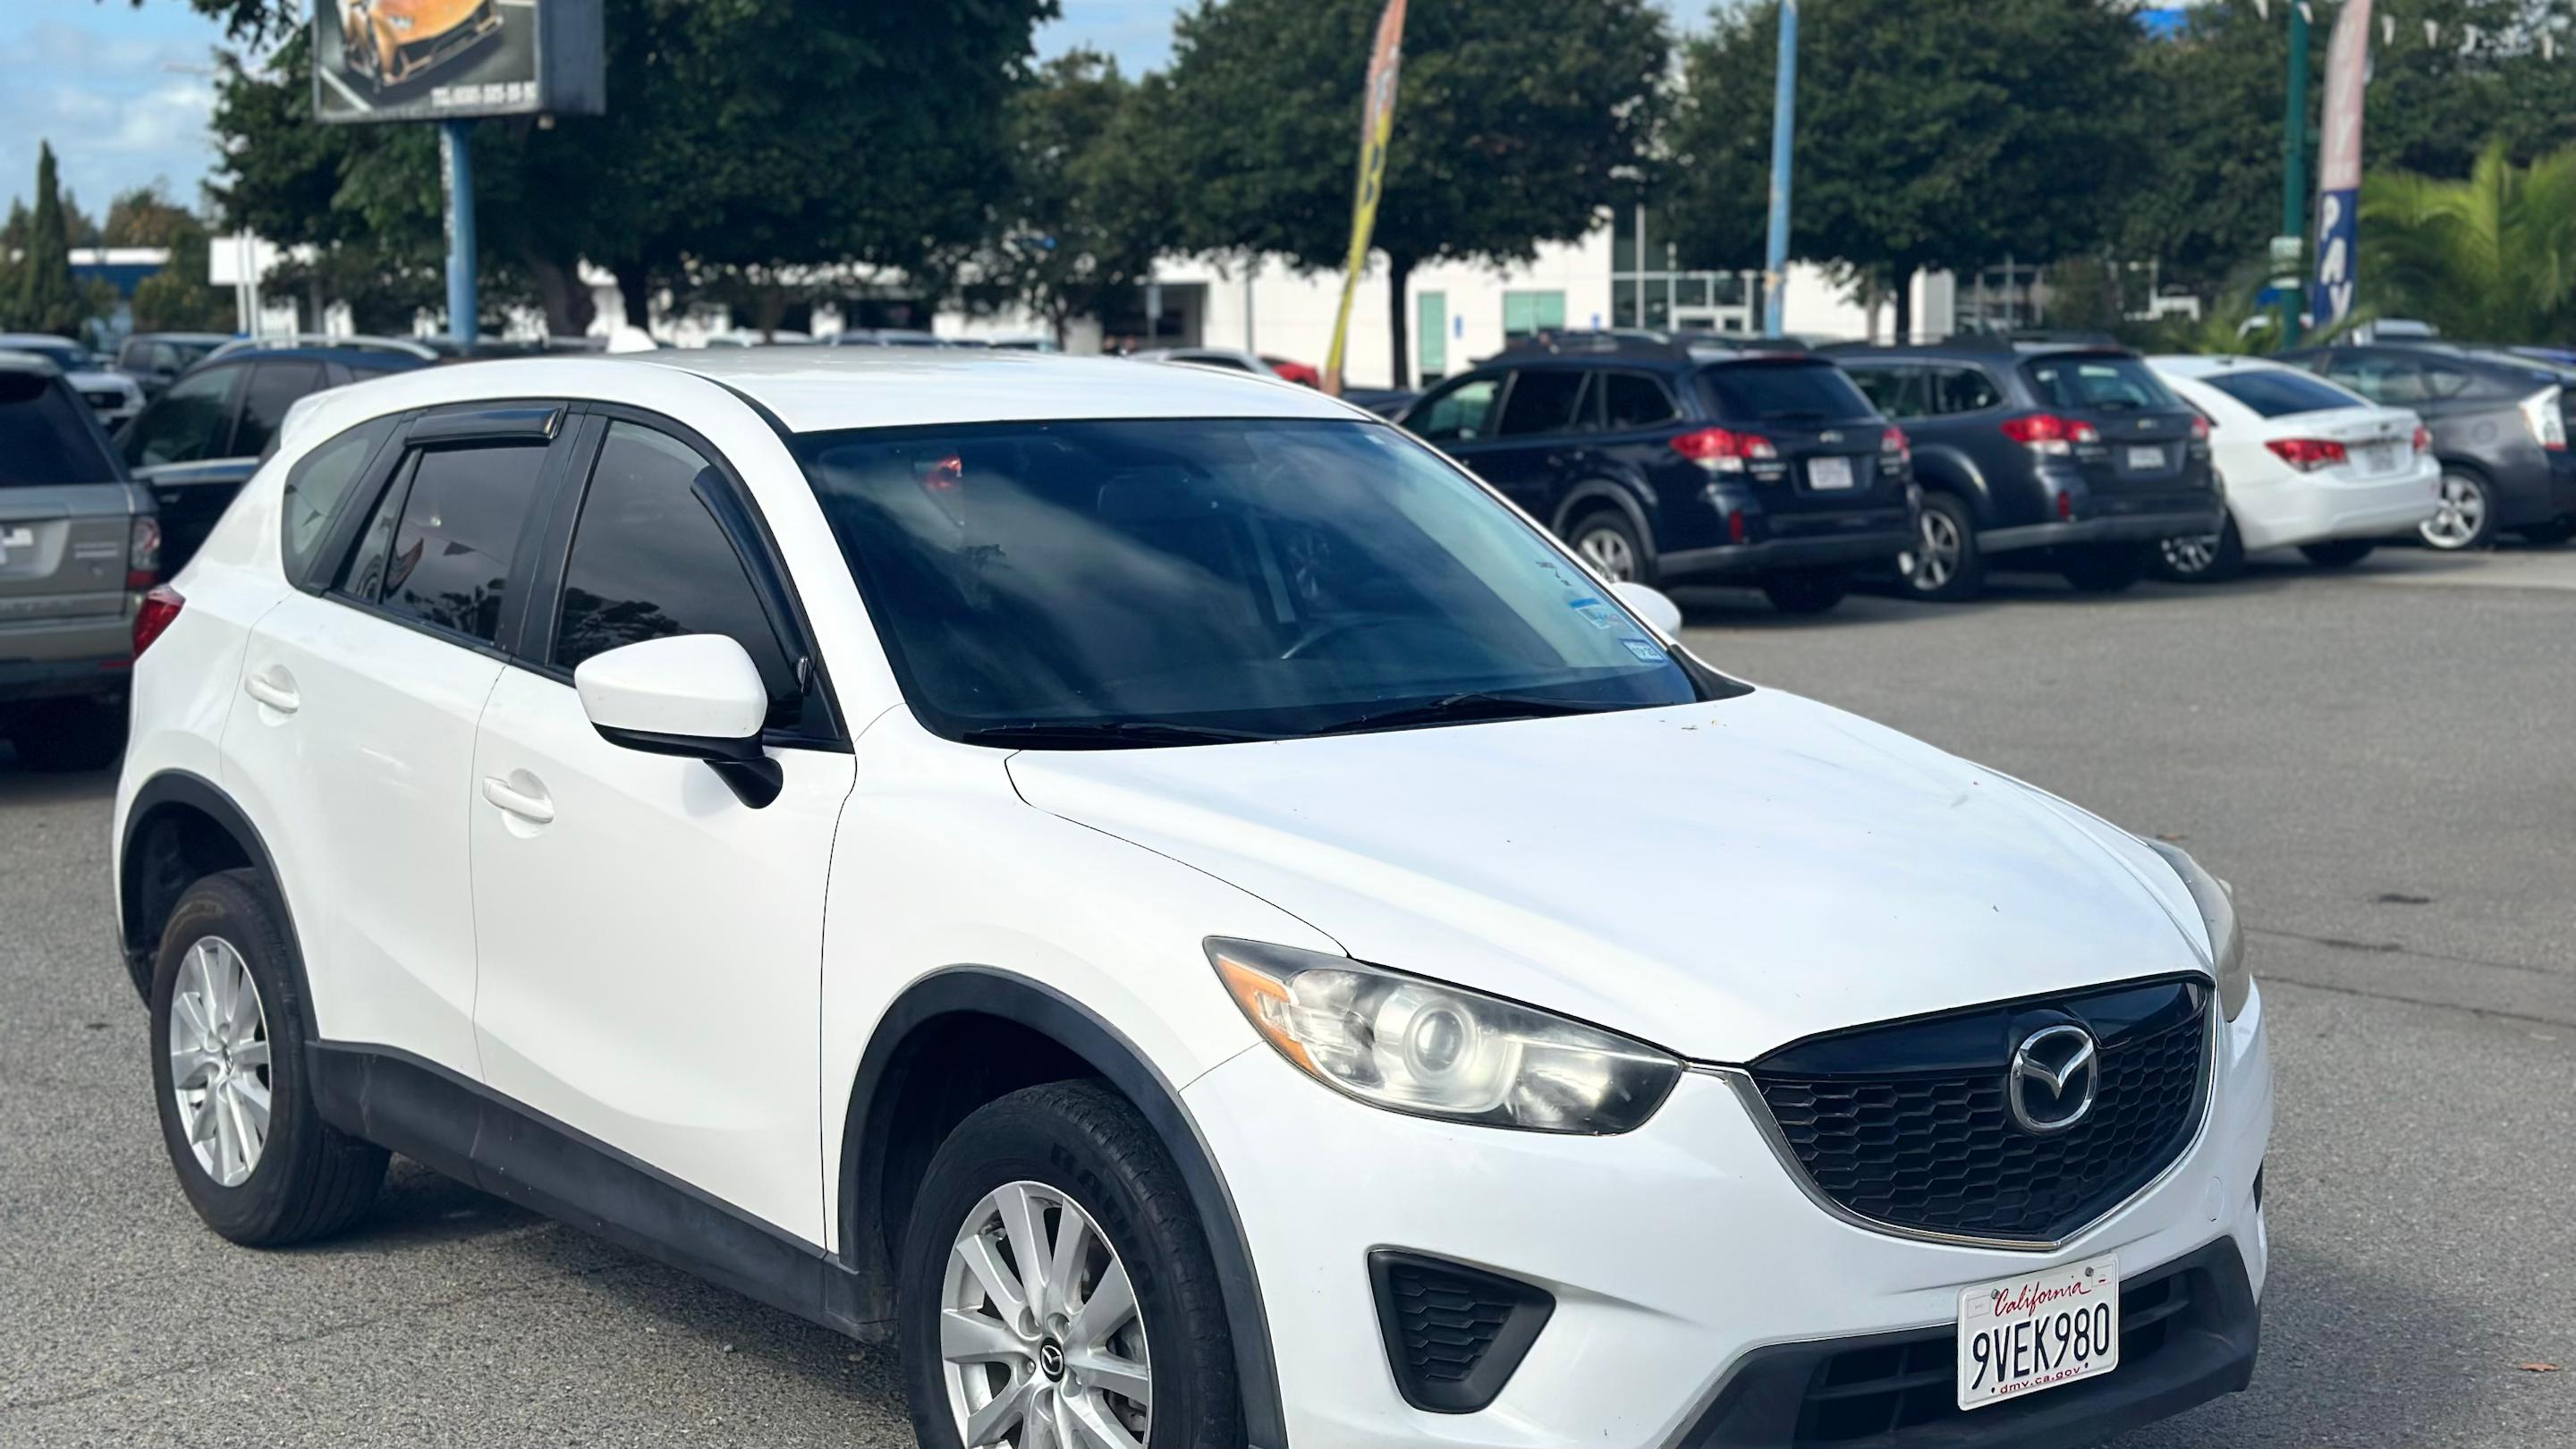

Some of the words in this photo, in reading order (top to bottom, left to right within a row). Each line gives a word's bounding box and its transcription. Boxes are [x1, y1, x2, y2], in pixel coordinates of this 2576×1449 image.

[2320, 193, 2352, 322] PAY
[1995, 1280, 2092, 1318] California
[1971, 1301, 2110, 1390] 9VEK980
[2000, 1366, 2081, 1394] dmv.ca.gov
